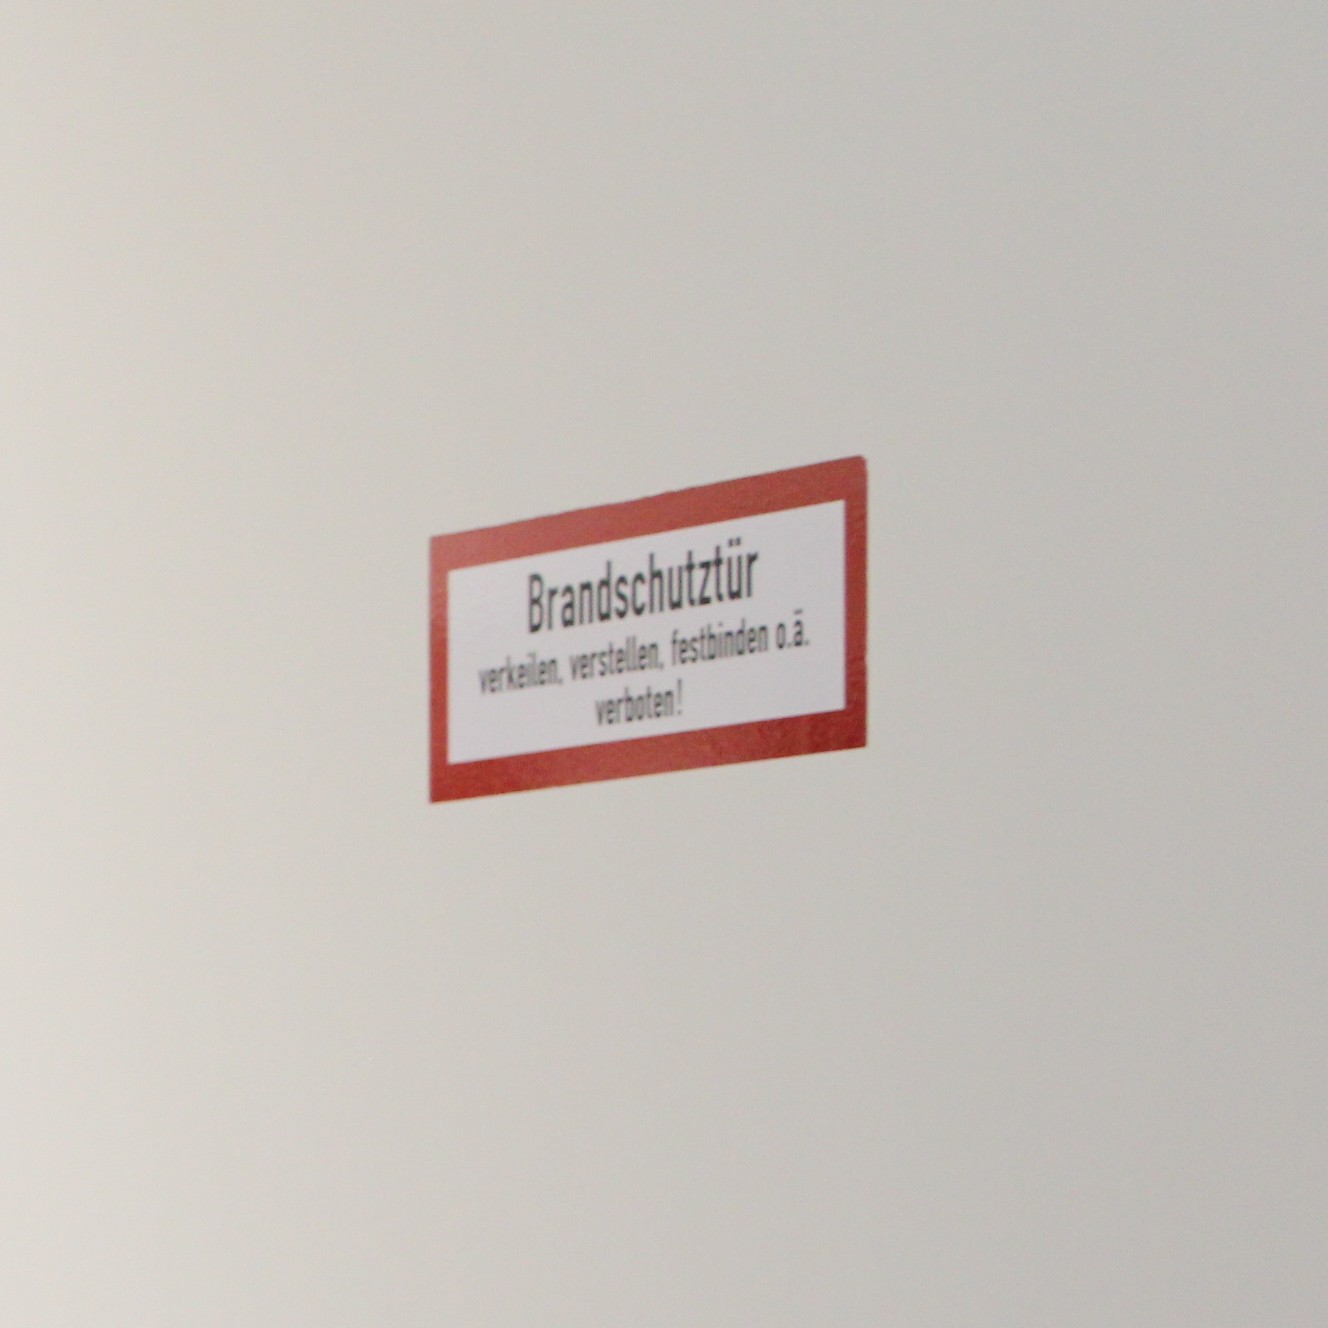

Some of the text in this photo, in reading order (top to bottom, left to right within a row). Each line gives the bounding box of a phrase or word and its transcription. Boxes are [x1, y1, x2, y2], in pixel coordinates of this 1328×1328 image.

[527, 537, 760, 633] Brandschutztür
[478, 609, 811, 695] verkeilen, verstellen, festbinden o.ä.
[594, 679, 683, 727] verboten!
